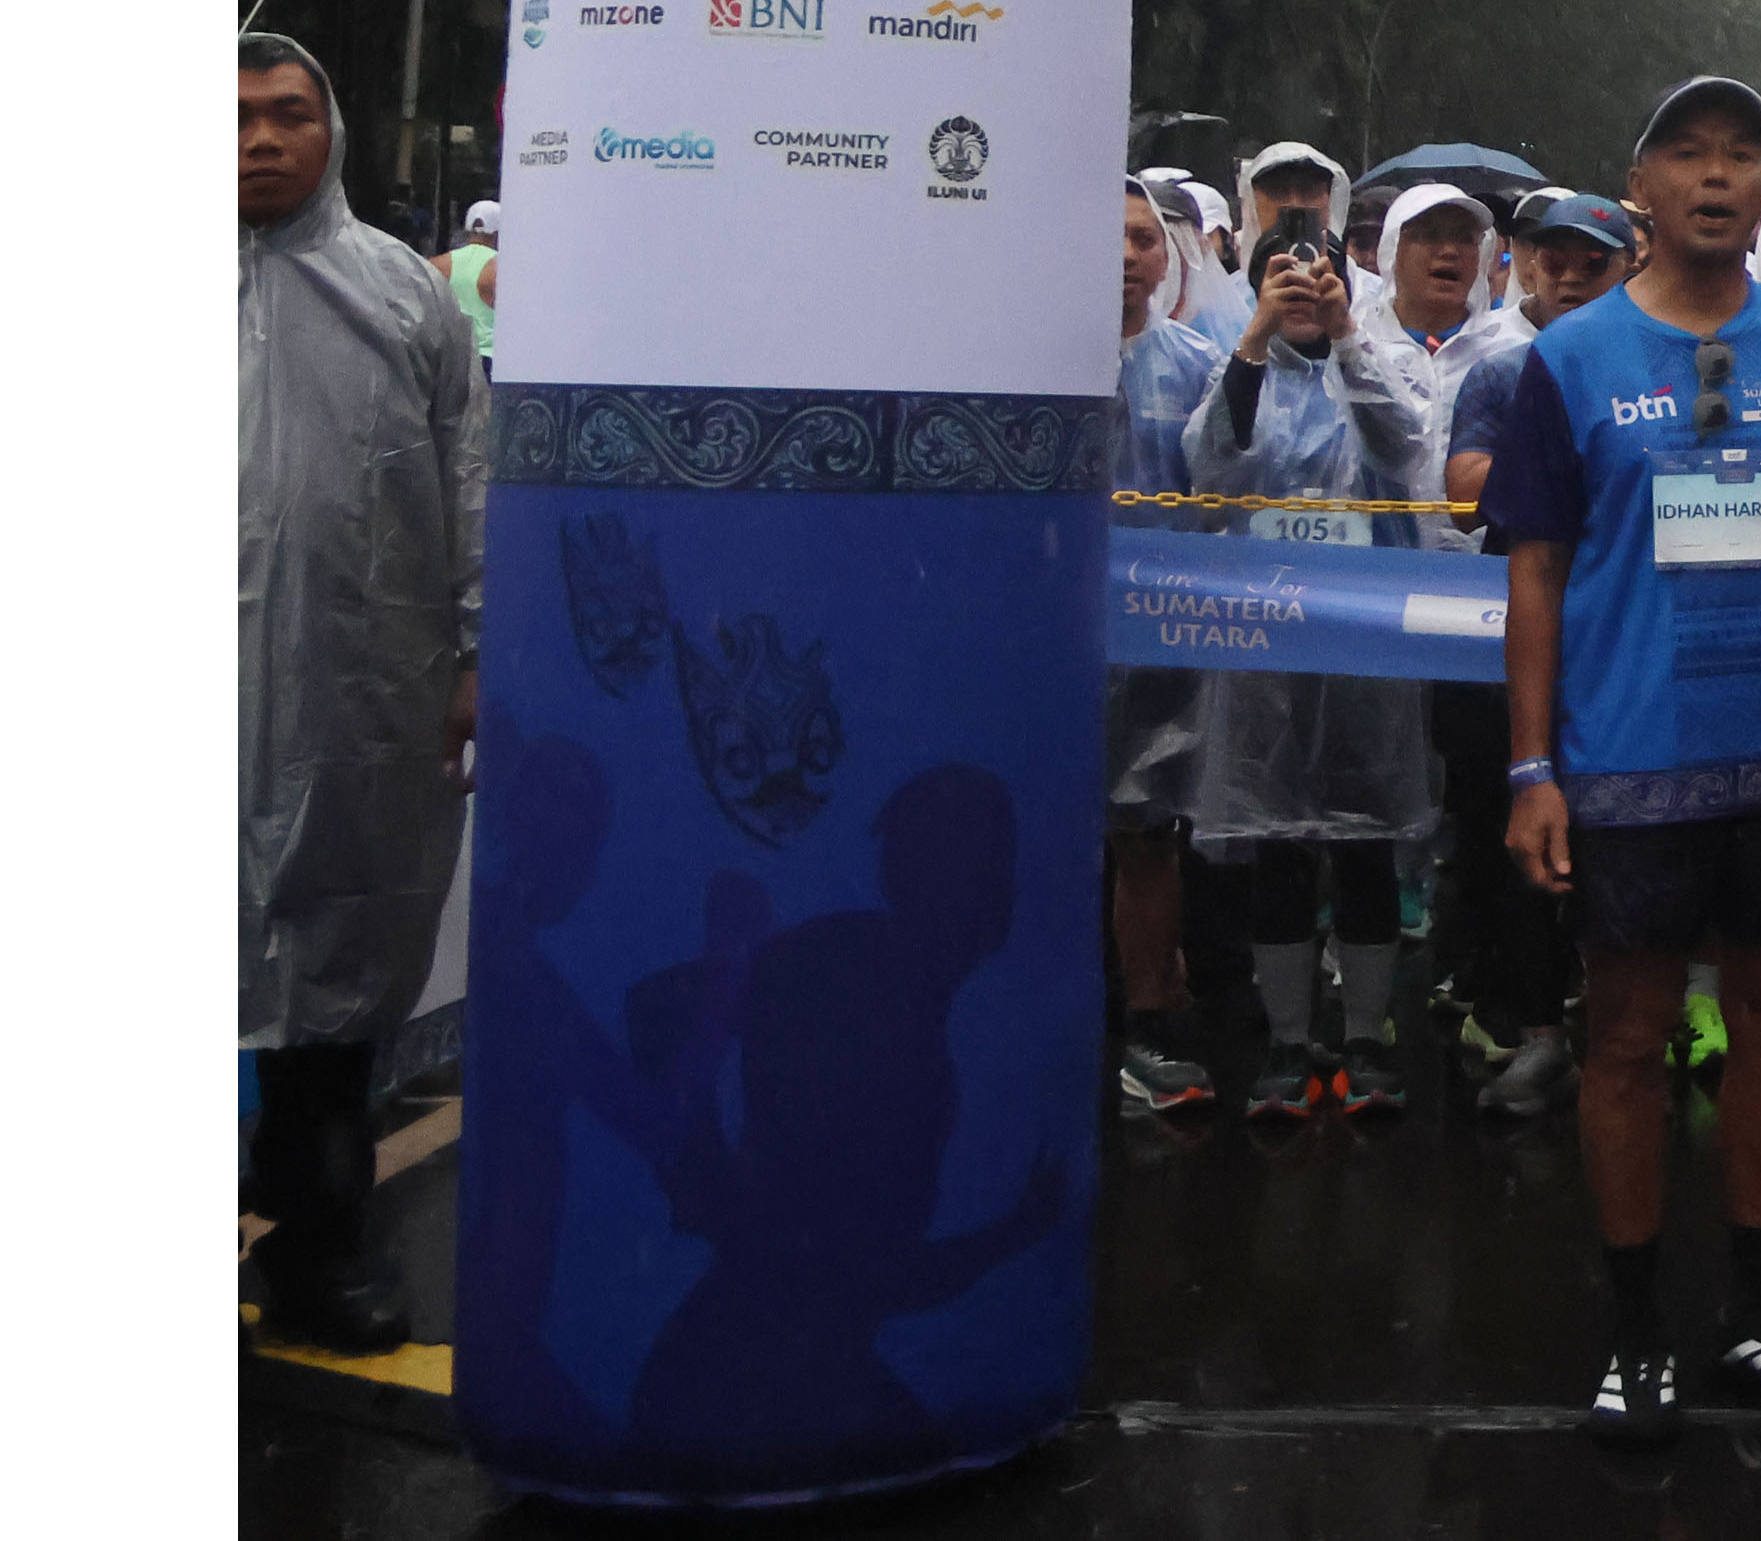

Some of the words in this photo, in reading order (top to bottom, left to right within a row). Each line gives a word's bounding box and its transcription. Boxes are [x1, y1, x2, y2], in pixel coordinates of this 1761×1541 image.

[580, 5, 664, 25] mizone
[869, 16, 977, 42] mandiri
[531, 131, 569, 146] MEDIA
[754, 131, 889, 150] COMMUNITY
[519, 150, 568, 166] PARTNER
[787, 152, 889, 169] PARTNER
[928, 186, 969, 199] ILUNI
[972, 188, 987, 200] UI
[1611, 385, 1677, 426] btn
[1657, 503, 1719, 520] IDHAN
[1275, 517, 1349, 542] 1054
[1124, 592, 1305, 622] SUMATERA
[1160, 622, 1270, 649] UTARA
